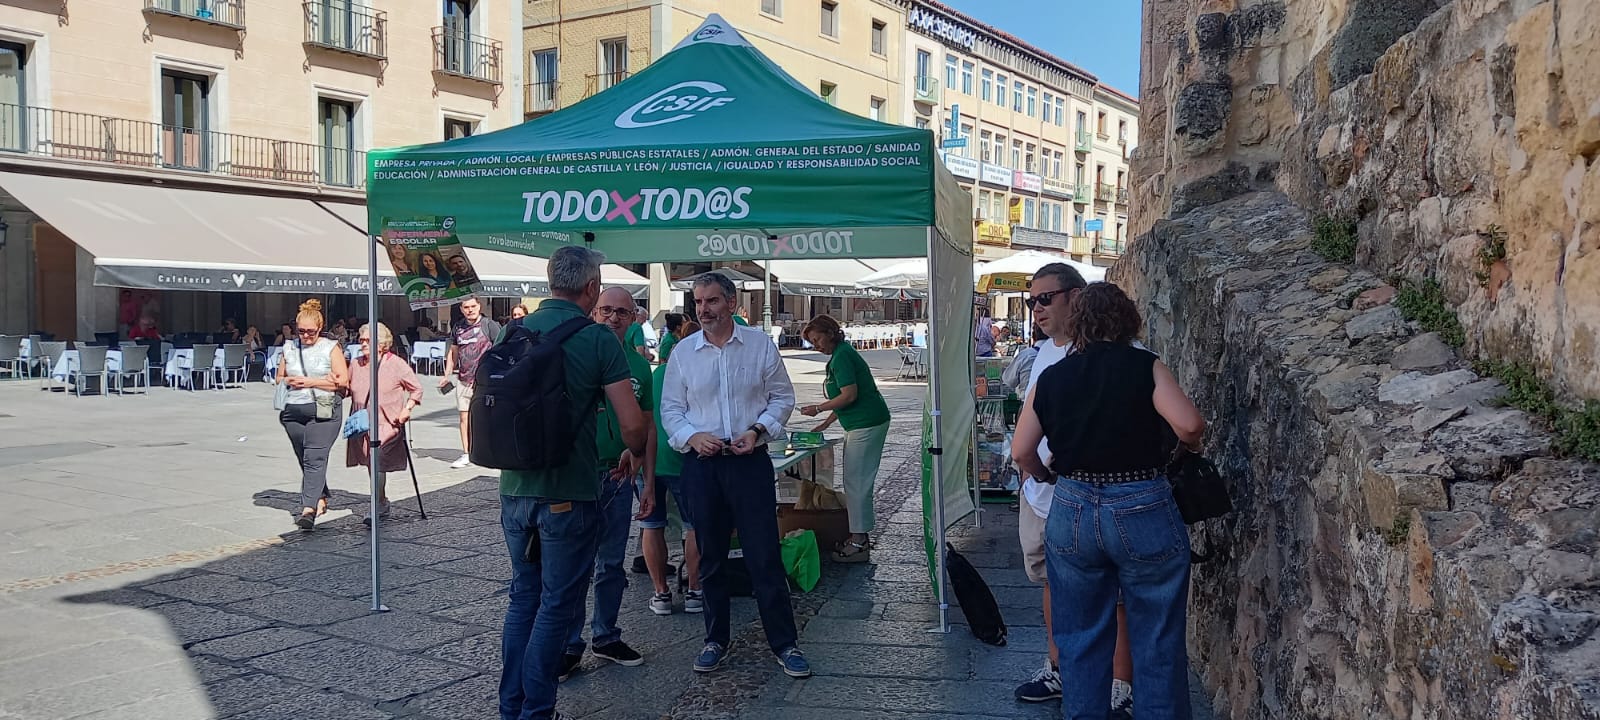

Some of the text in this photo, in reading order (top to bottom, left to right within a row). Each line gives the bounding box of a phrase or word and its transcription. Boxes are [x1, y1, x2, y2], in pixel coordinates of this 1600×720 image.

[909, 6, 976, 50] AXA SEGUROS
[374, 159, 416, 168] EMPRESA
[465, 154, 503, 165] ADMÓN.
[506, 154, 536, 164] LOCAL
[546, 152, 597, 162] EMPRESAS
[600, 149, 646, 160] PÚBLICAS
[648, 149, 700, 159] ESTATALES
[710, 146, 752, 158] ADMÓN.
[755, 147, 800, 157] GENERAL
[802, 146, 820, 155] DEL
[823, 144, 864, 155] ESTADO
[874, 142, 921, 153] SANIDAD
[374, 169, 427, 180] EDUCACIÓN
[437, 165, 517, 178] ADMINISTRACIÓN
[519, 165, 561, 175] GENERAL
[563, 165, 575, 174] DE
[577, 163, 623, 173] CASTILLA
[625, 163, 632, 171] Y
[634, 160, 659, 171] LEÓN
[669, 162, 713, 171] JUSTICIA
[723, 160, 774, 171] IGUALDAD
[776, 160, 784, 169] Y
[786, 157, 879, 169] RESPONSABILIDAD
[881, 156, 921, 166] SOCIAL
[988, 225, 1003, 236] ORO
[1002, 279, 1020, 287] ONCE
